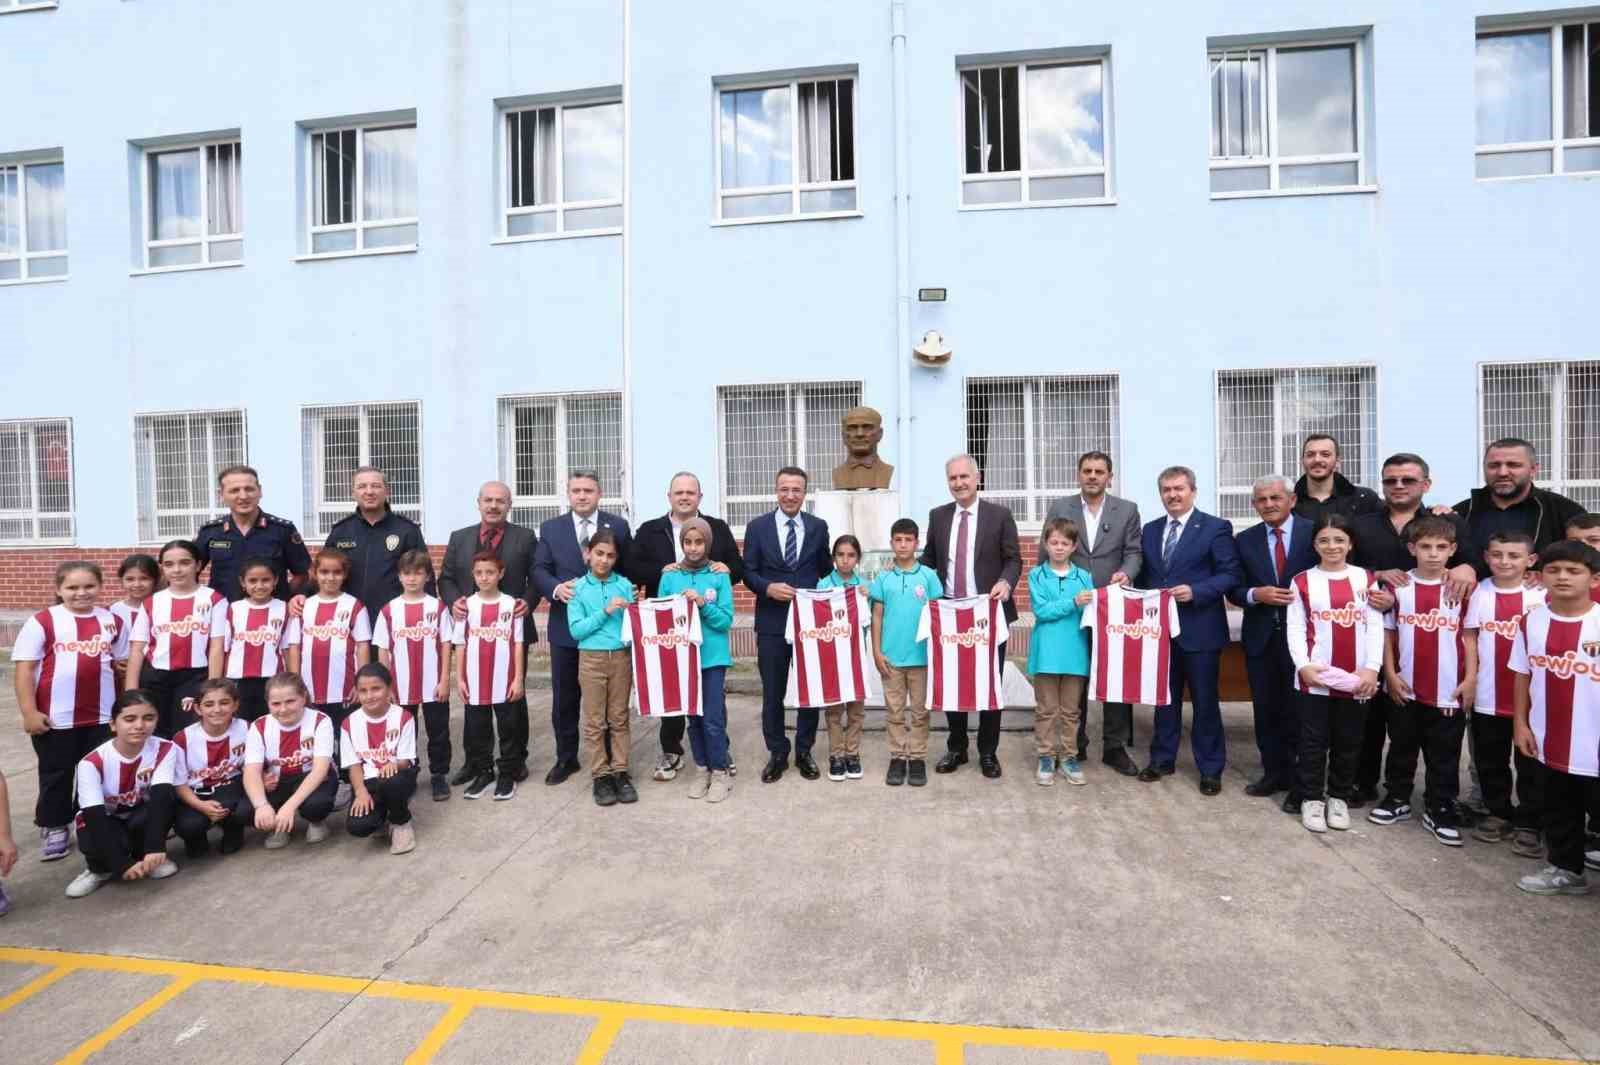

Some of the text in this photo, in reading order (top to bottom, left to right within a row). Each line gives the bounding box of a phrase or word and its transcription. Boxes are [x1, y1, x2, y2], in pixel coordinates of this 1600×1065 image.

[1106, 620, 1162, 639] newjoy
[1398, 610, 1459, 631] newjoy
[641, 628, 690, 648] newjoy
[800, 621, 852, 641] newjoy
[941, 628, 990, 647] newjoy
